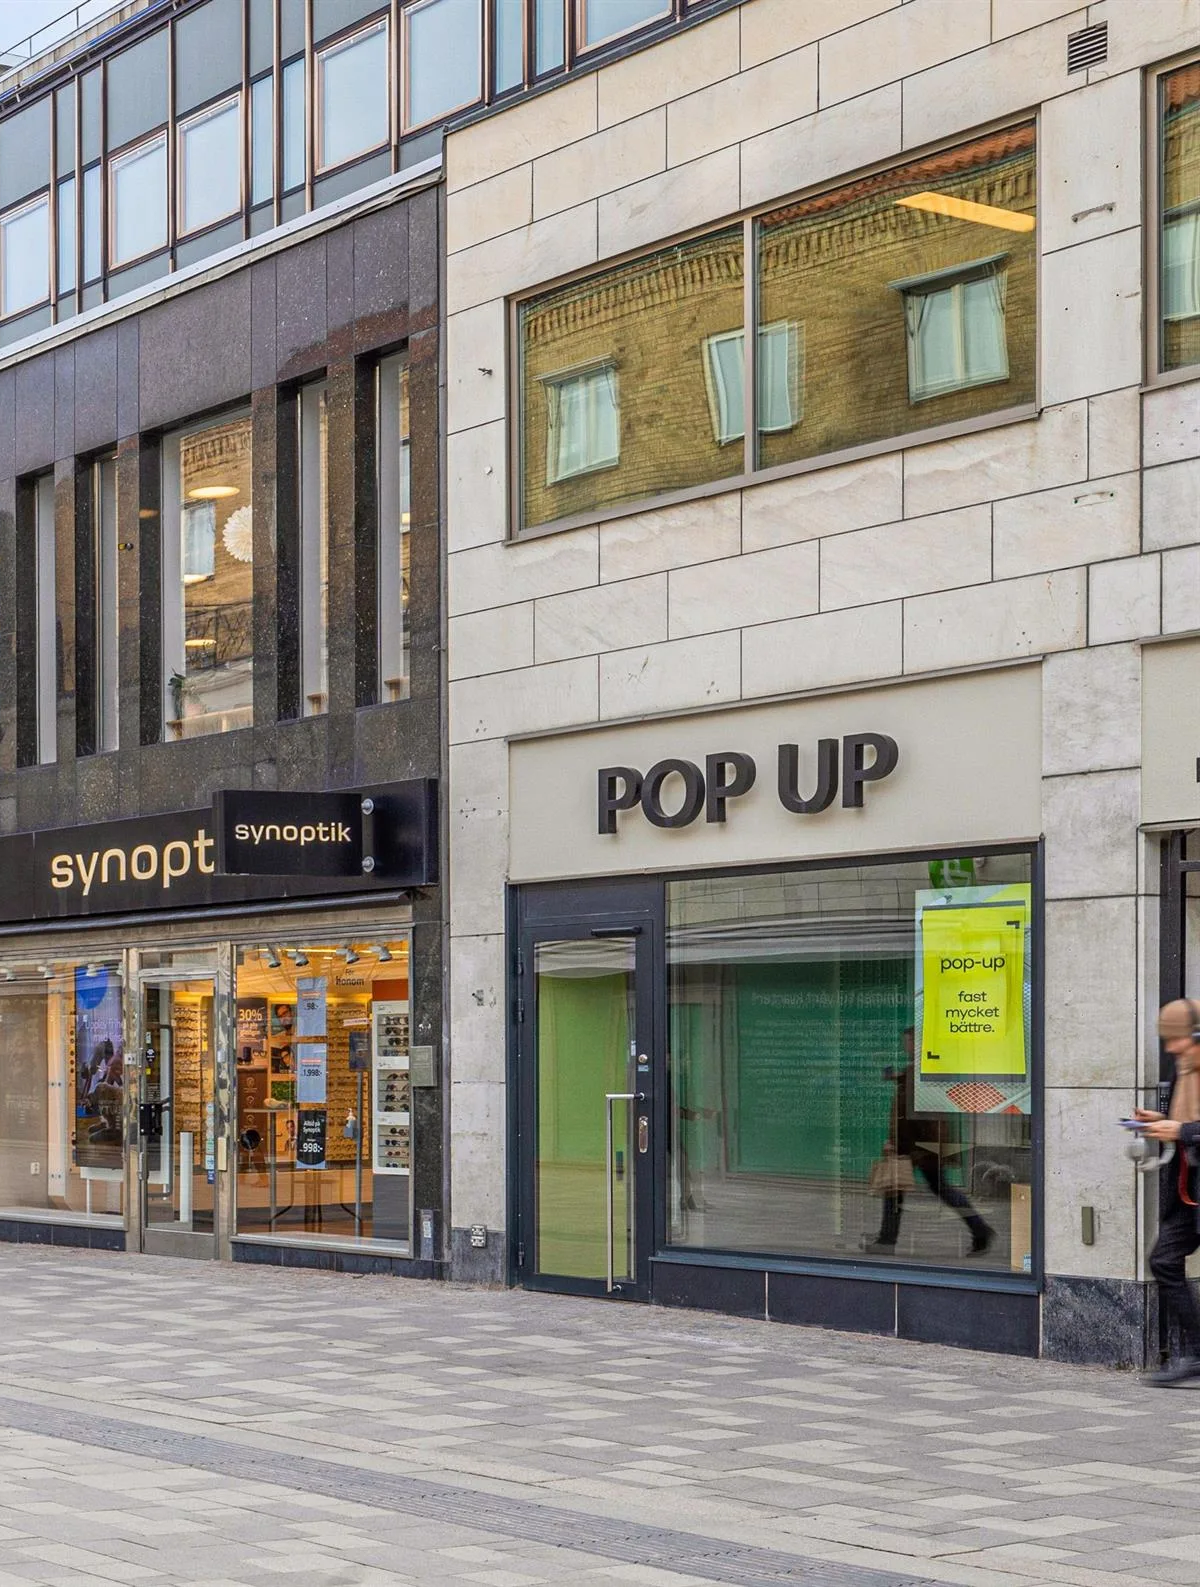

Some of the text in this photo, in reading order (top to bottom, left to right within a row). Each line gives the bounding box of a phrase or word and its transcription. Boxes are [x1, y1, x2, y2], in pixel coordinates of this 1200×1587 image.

[598, 732, 899, 834] POP UP
[234, 822, 351, 846] synoptik
[51, 829, 215, 896] synopt
[940, 955, 1005, 973] pop-up
[958, 990, 987, 1002] fast
[239, 1008, 263, 1021] 30%
[945, 1006, 1000, 1020] mycket
[950, 1021, 995, 1033] bättre.
